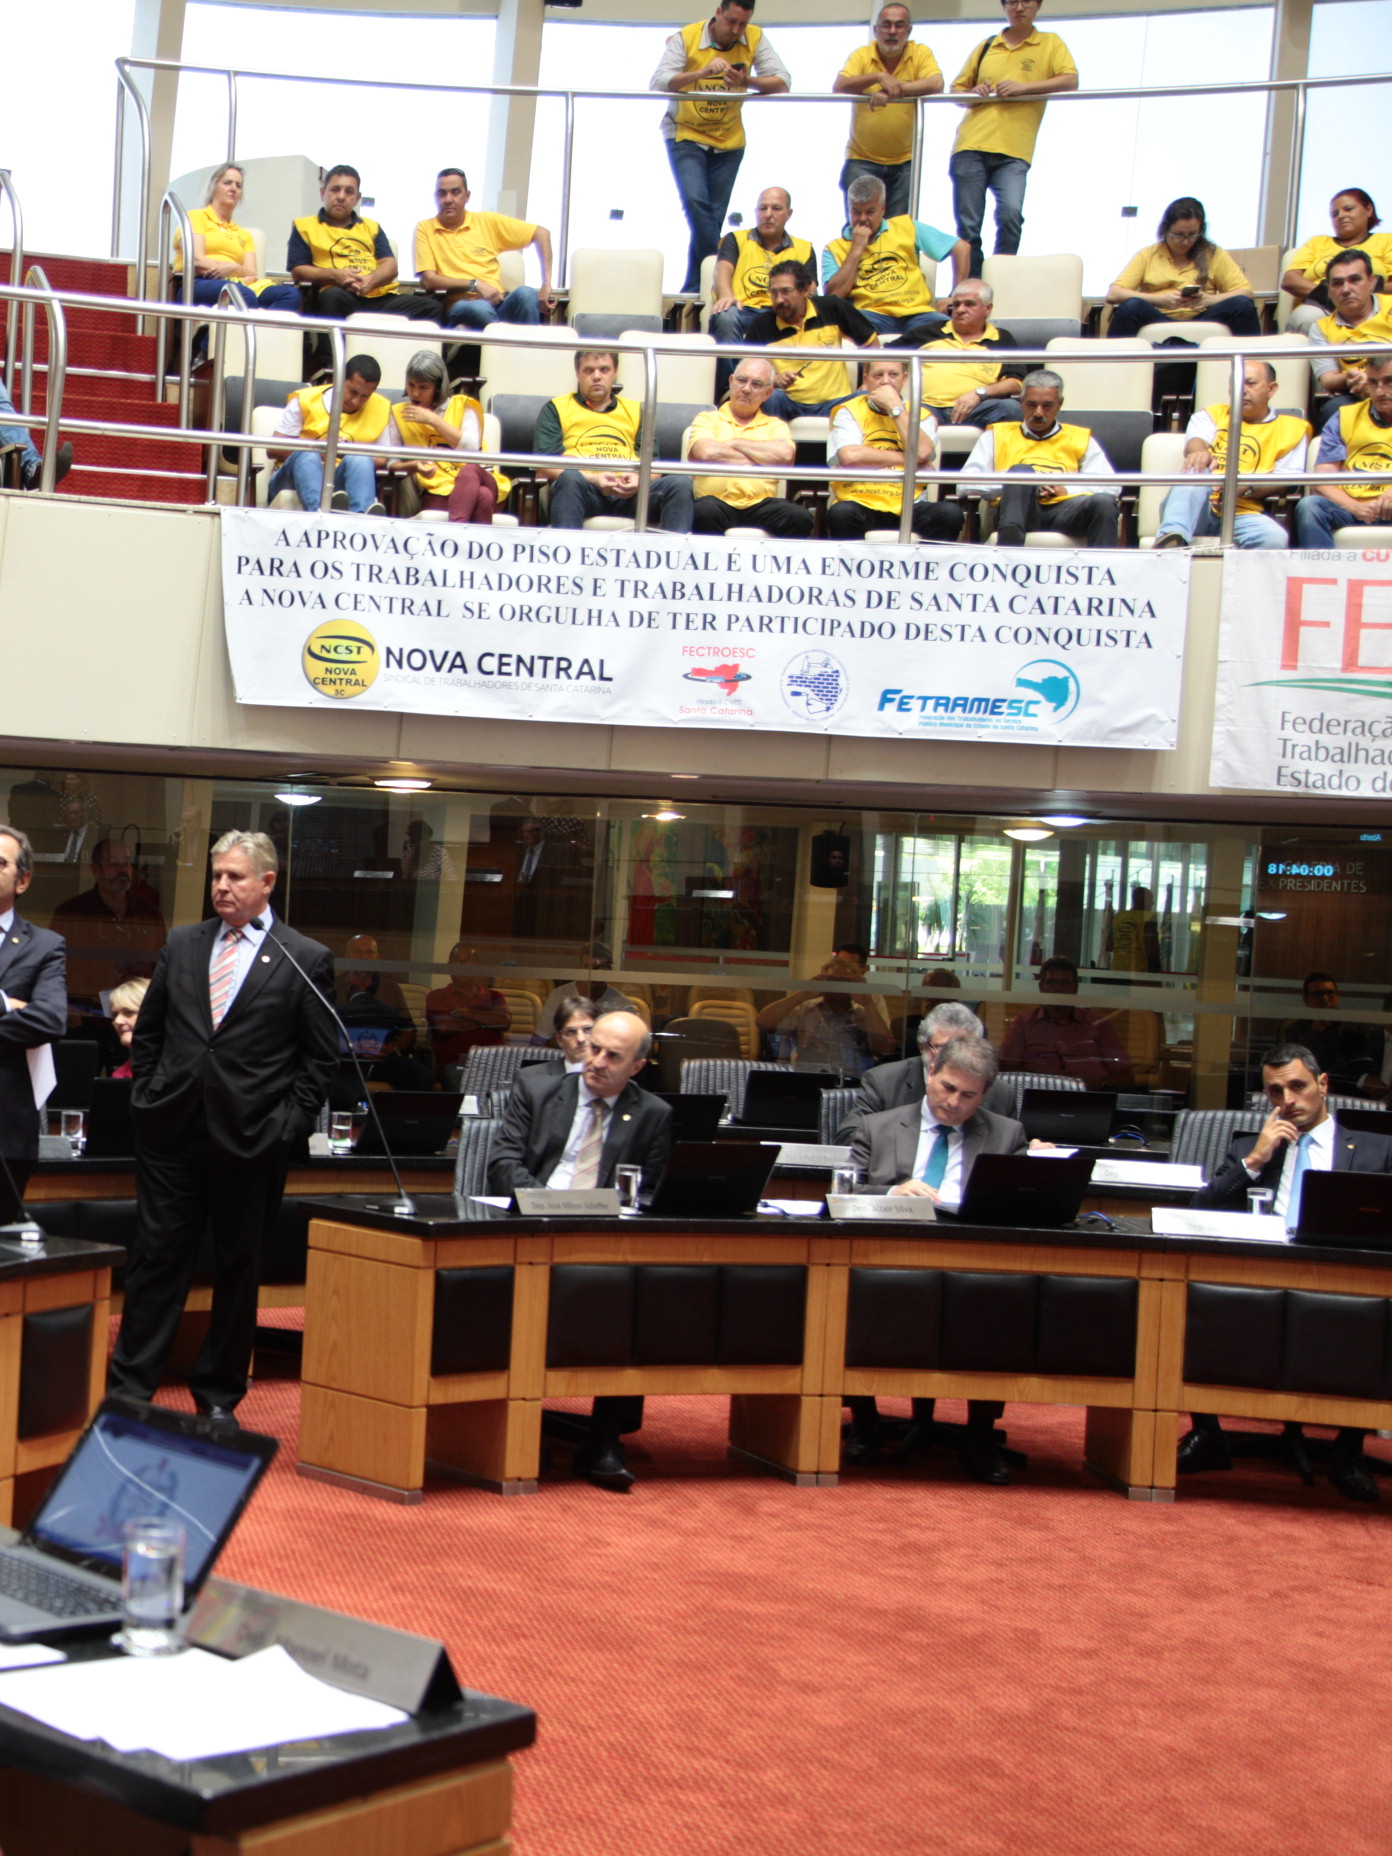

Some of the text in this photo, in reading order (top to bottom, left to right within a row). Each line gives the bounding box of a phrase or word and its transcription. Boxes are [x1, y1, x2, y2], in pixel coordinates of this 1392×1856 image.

[275, 528, 1118, 588] A APROVAÇÃO DO PISO ESTADUAL É UMA ENORME CONQUISTA
[1362, 548, 1392, 563] CU
[236, 555, 1159, 620] PARA OS TRABALHADORES E TRABALHADORAS DE SANTA CATARINA
[239, 588, 1155, 651] A NOVA CENTRAL SE ORGULHA DE TER PARTICIPADO DESTA CONQUISTA
[319, 644, 363, 655] NCST
[682, 645, 756, 659] FECTROESC
[325, 666, 358, 677] NOVA
[385, 646, 614, 683] NOVA CENTRAL
[313, 677, 368, 688] CENTRAL
[438, 677, 519, 691] TRABALHADORES
[534, 682, 564, 693] SANTA
[334, 689, 346, 697] SC
[679, 705, 753, 717] Santa Catarina
[1280, 711, 1392, 743] Federaçã
[1276, 765, 1361, 792] Estado
